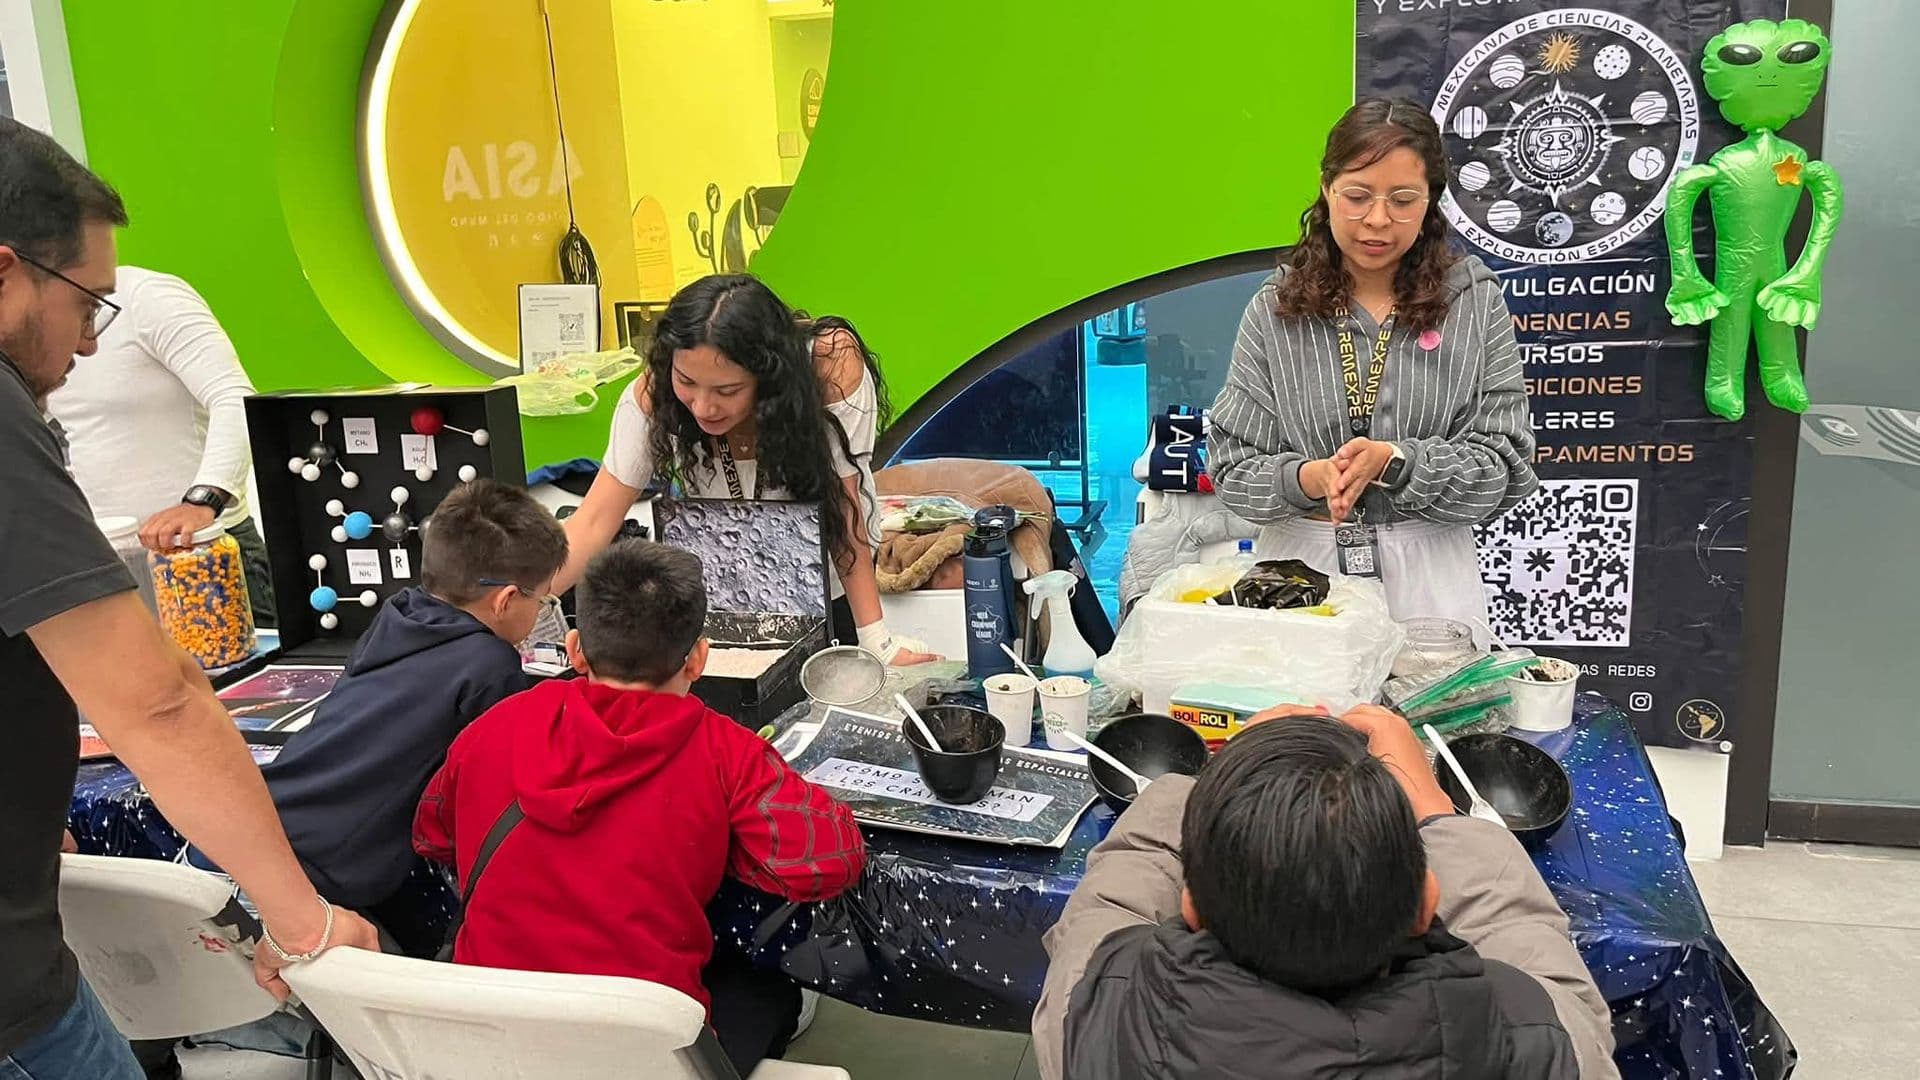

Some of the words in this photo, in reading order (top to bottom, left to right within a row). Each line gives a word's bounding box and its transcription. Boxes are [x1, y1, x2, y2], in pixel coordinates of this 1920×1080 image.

[1437, 31, 1510, 111] MEXICANA
[1515, 18, 1539, 35] DE
[1546, 12, 1634, 36] CIENCIAS
[1635, 31, 1697, 139] PLANETARIAS
[1456, 214, 1467, 226] Y
[1465, 228, 1581, 263] EXPLORACIÓN
[1586, 205, 1664, 256] ESPACIAL
[1338, 331, 1363, 418] REMEXPE
[1362, 330, 1392, 416] REMEXPE
[1531, 443, 1695, 465] PAMENTOS
[395, 555, 404, 569] R
[1607, 664, 1657, 678] REDES
[843, 722, 893, 741] EVENTOS
[1015, 759, 1090, 781] ESPACIALES
[839, 775, 876, 789] LOS
